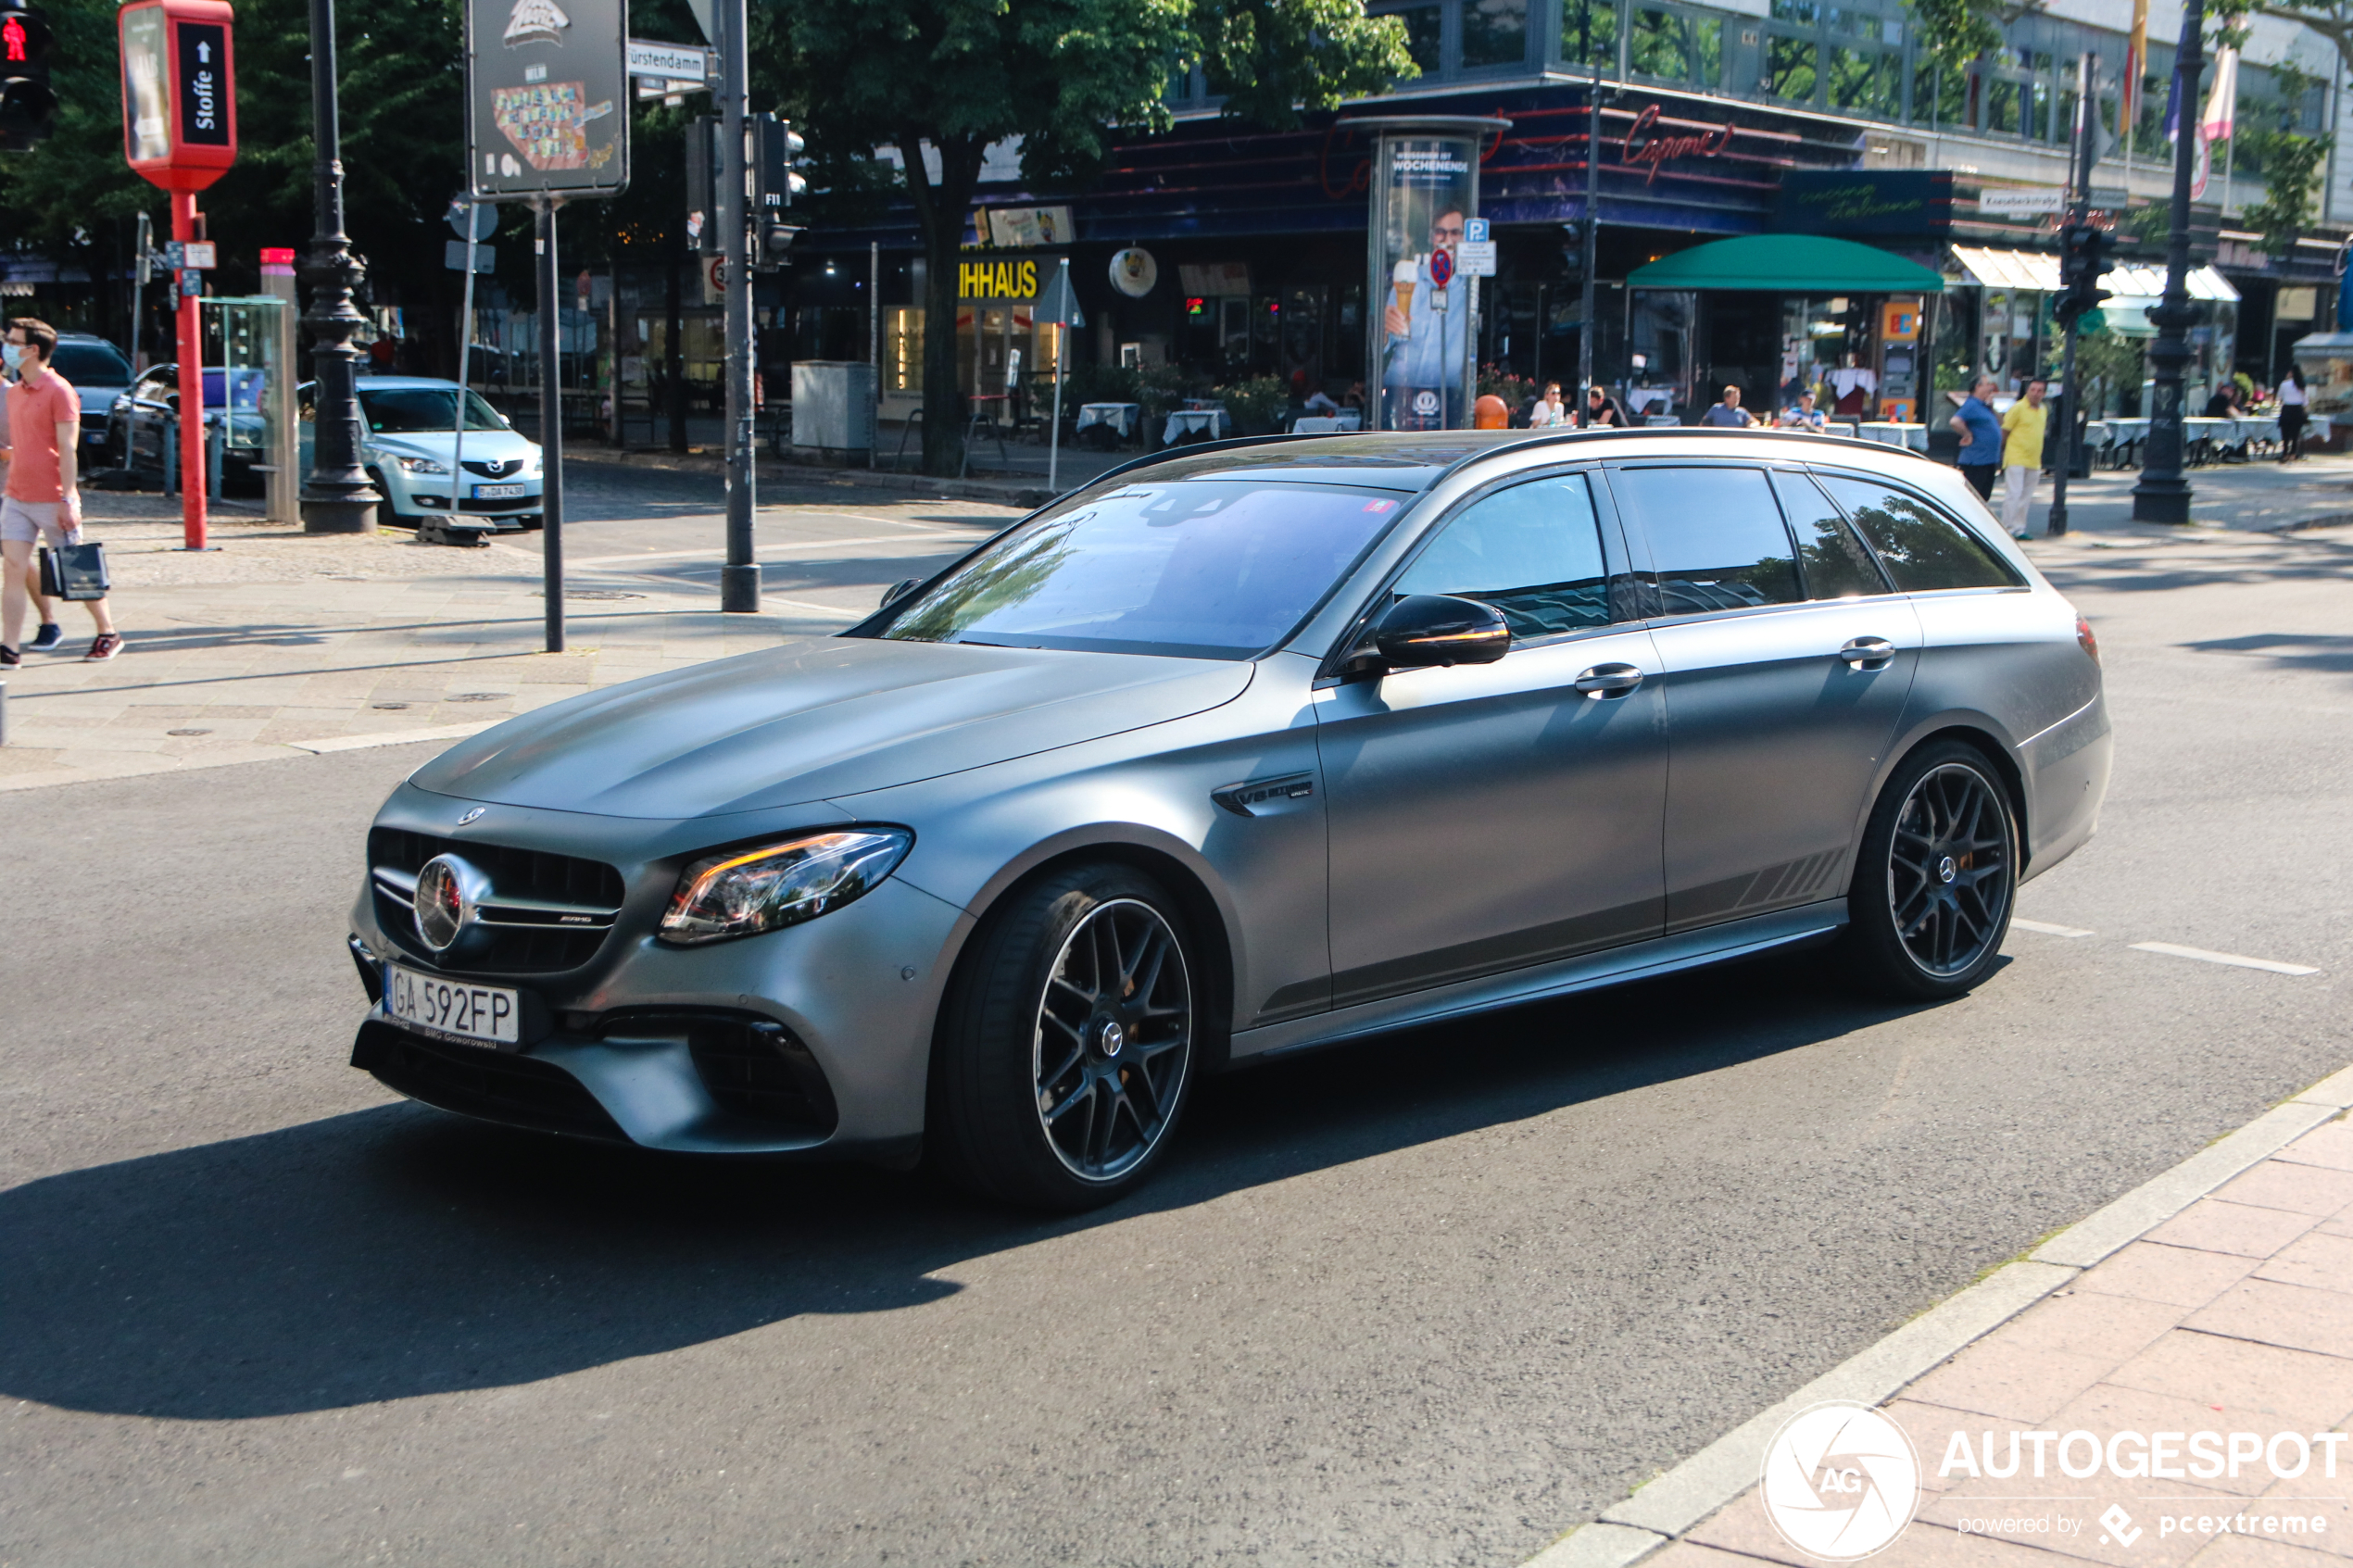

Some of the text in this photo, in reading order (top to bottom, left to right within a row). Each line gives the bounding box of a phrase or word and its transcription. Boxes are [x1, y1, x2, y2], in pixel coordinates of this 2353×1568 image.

[628, 50, 701, 71] ürstendamm
[193, 70, 215, 130] Stoffe
[765, 193, 781, 206] F11
[1469, 222, 1484, 241] P
[958, 259, 1038, 299] IHHAUS
[1890, 313, 1911, 334] EC
[1238, 790, 1267, 805] V8
[395, 972, 511, 1035] GA 592FP
[445, 1032, 497, 1050] Goworowski
